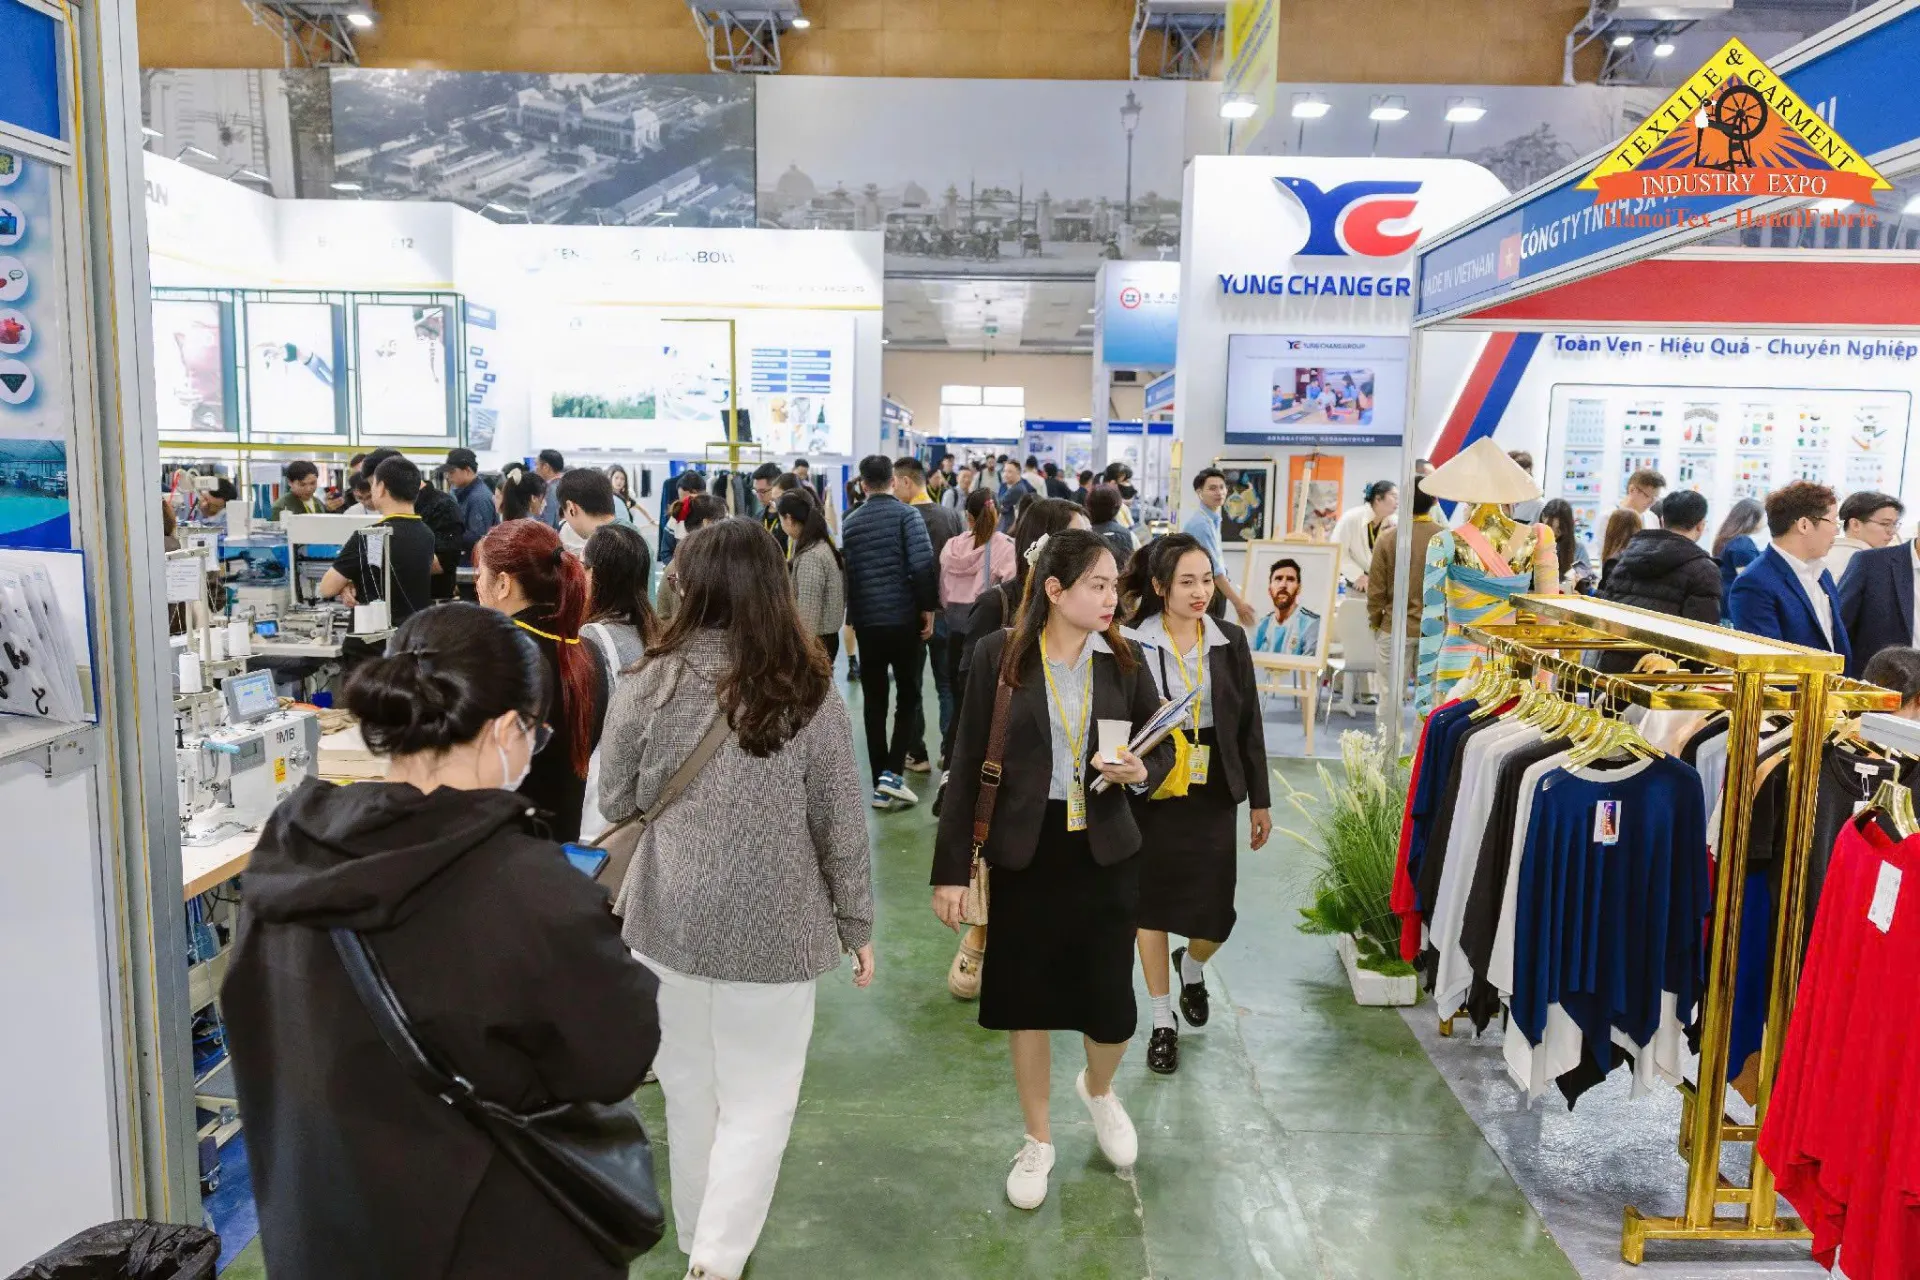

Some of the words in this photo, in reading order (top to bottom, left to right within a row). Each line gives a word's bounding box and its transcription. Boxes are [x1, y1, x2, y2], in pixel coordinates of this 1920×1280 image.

[1454, 252, 1494, 287] VIETNAM
[1562, 212, 1581, 244] TY
[1219, 273, 1285, 296] YUNG
[1555, 334, 1600, 352] Toàn
[1606, 336, 1642, 356] Vẹn
[1660, 336, 1704, 358] Hiệu
[1710, 336, 1750, 355] Quả
[1767, 337, 1840, 359] Chuyên
[1847, 339, 1918, 361] Nghiệp
